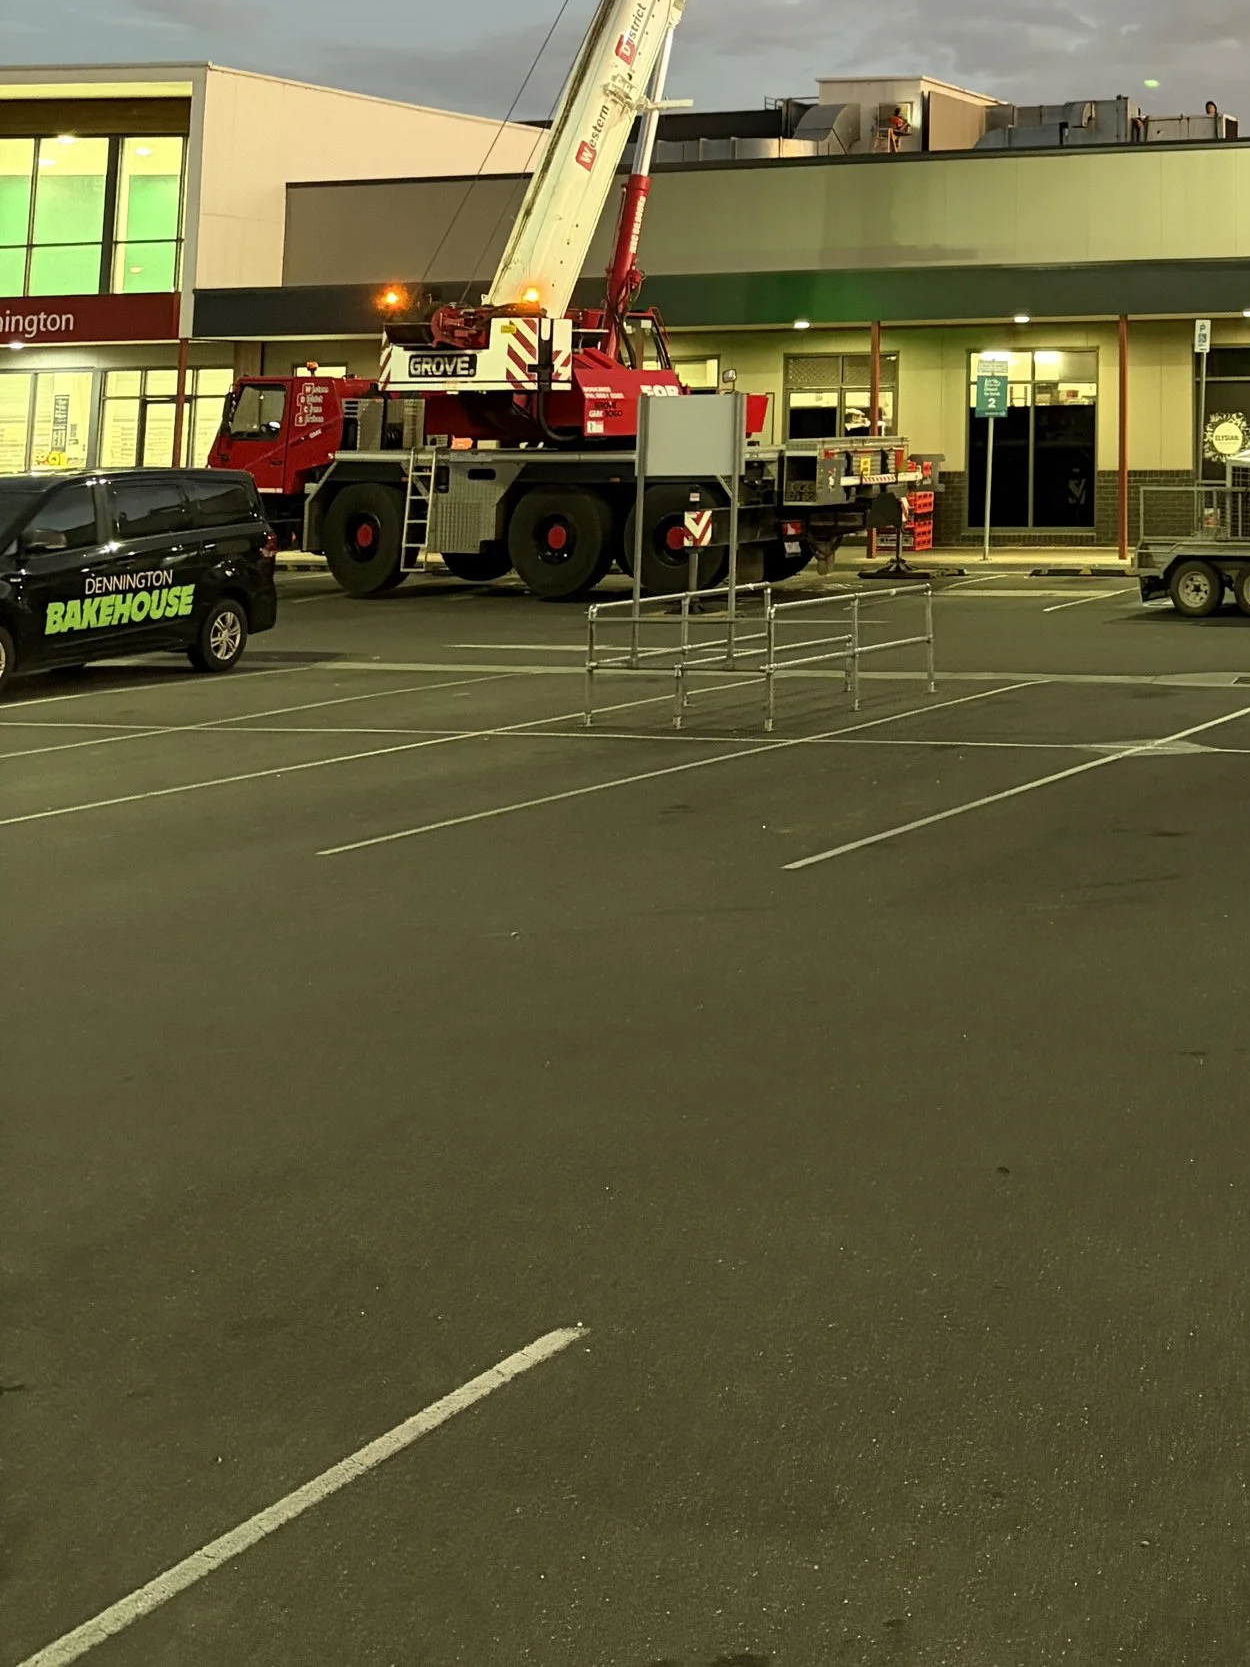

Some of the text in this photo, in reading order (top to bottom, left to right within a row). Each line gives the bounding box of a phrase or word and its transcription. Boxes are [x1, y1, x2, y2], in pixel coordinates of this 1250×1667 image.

[580, 105, 610, 167] Western
[619, 2, 647, 60] District
[0, 310, 74, 338] ington
[988, 397, 996, 409] 2
[85, 569, 174, 595] DENNINGTON
[44, 583, 196, 635] BAKEHOUSE
